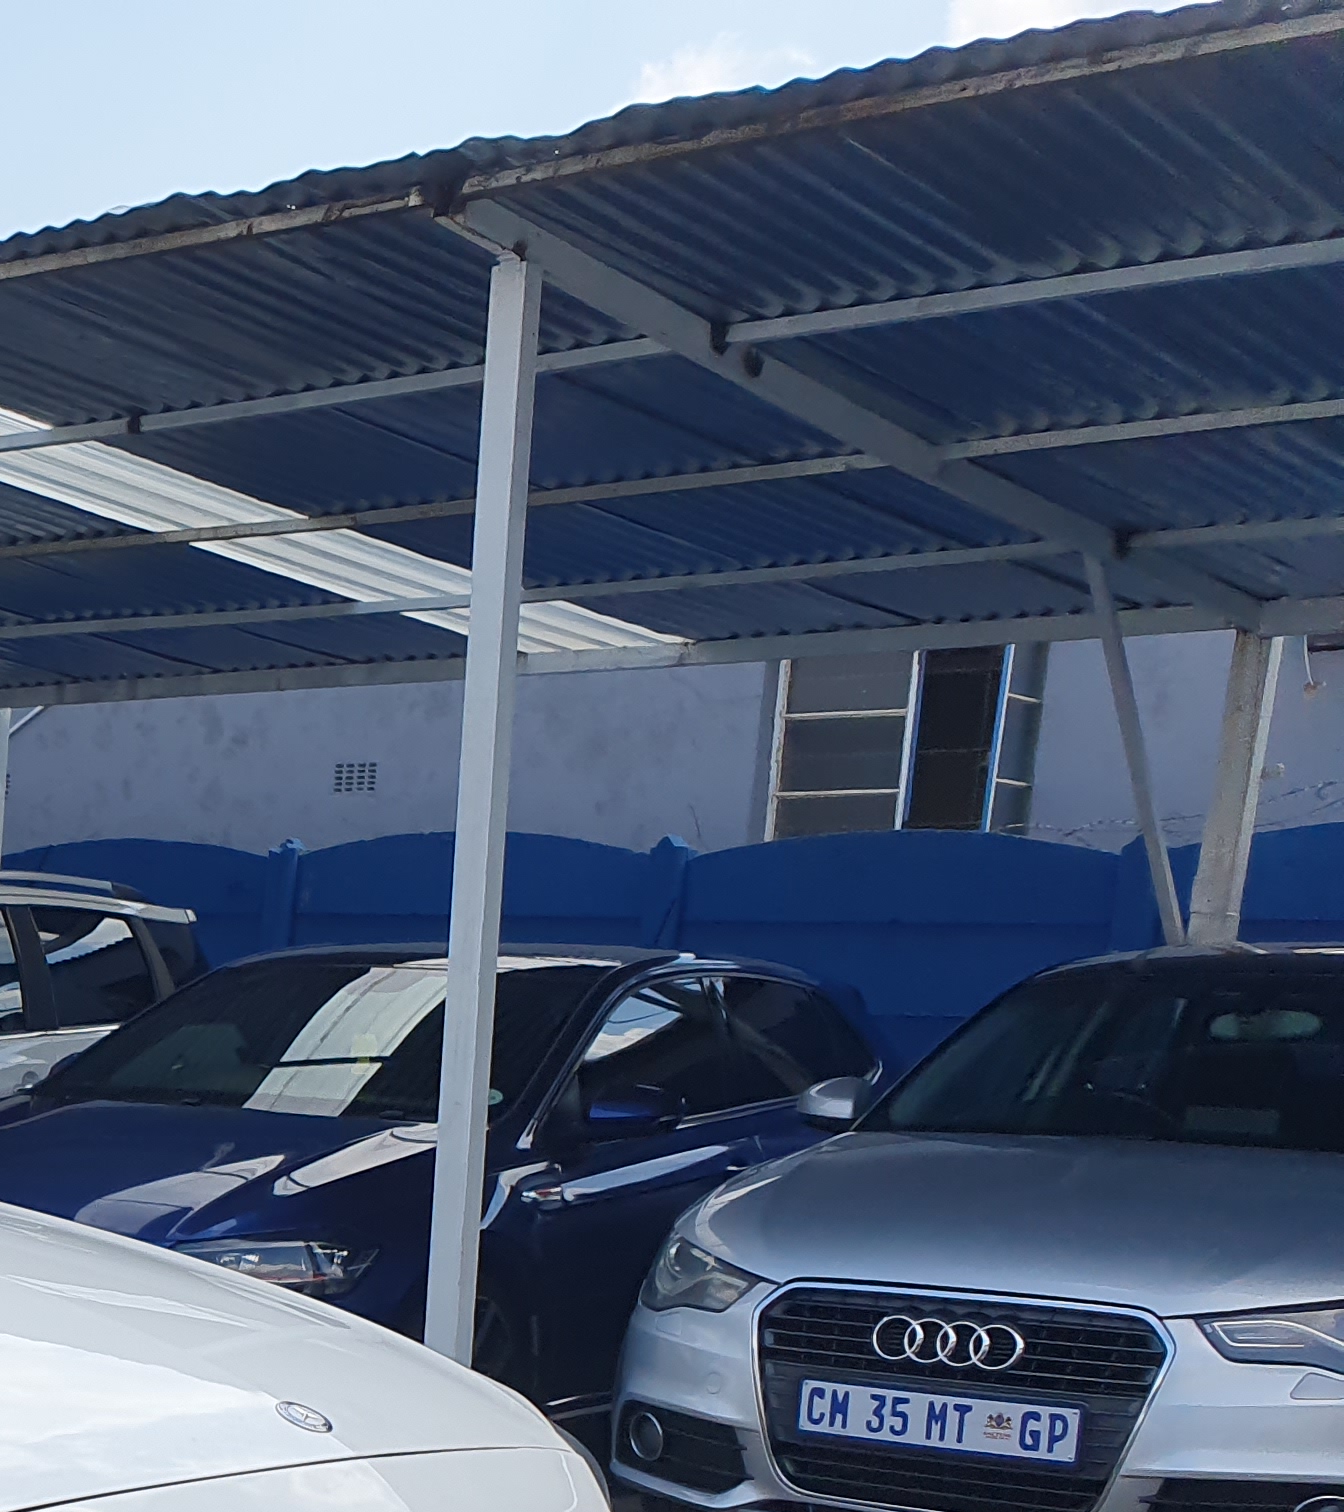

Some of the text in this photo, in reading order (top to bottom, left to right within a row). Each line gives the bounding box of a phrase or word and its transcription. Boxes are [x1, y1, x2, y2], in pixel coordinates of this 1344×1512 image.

[806, 1386, 1069, 1454] CM 35 MT GP
